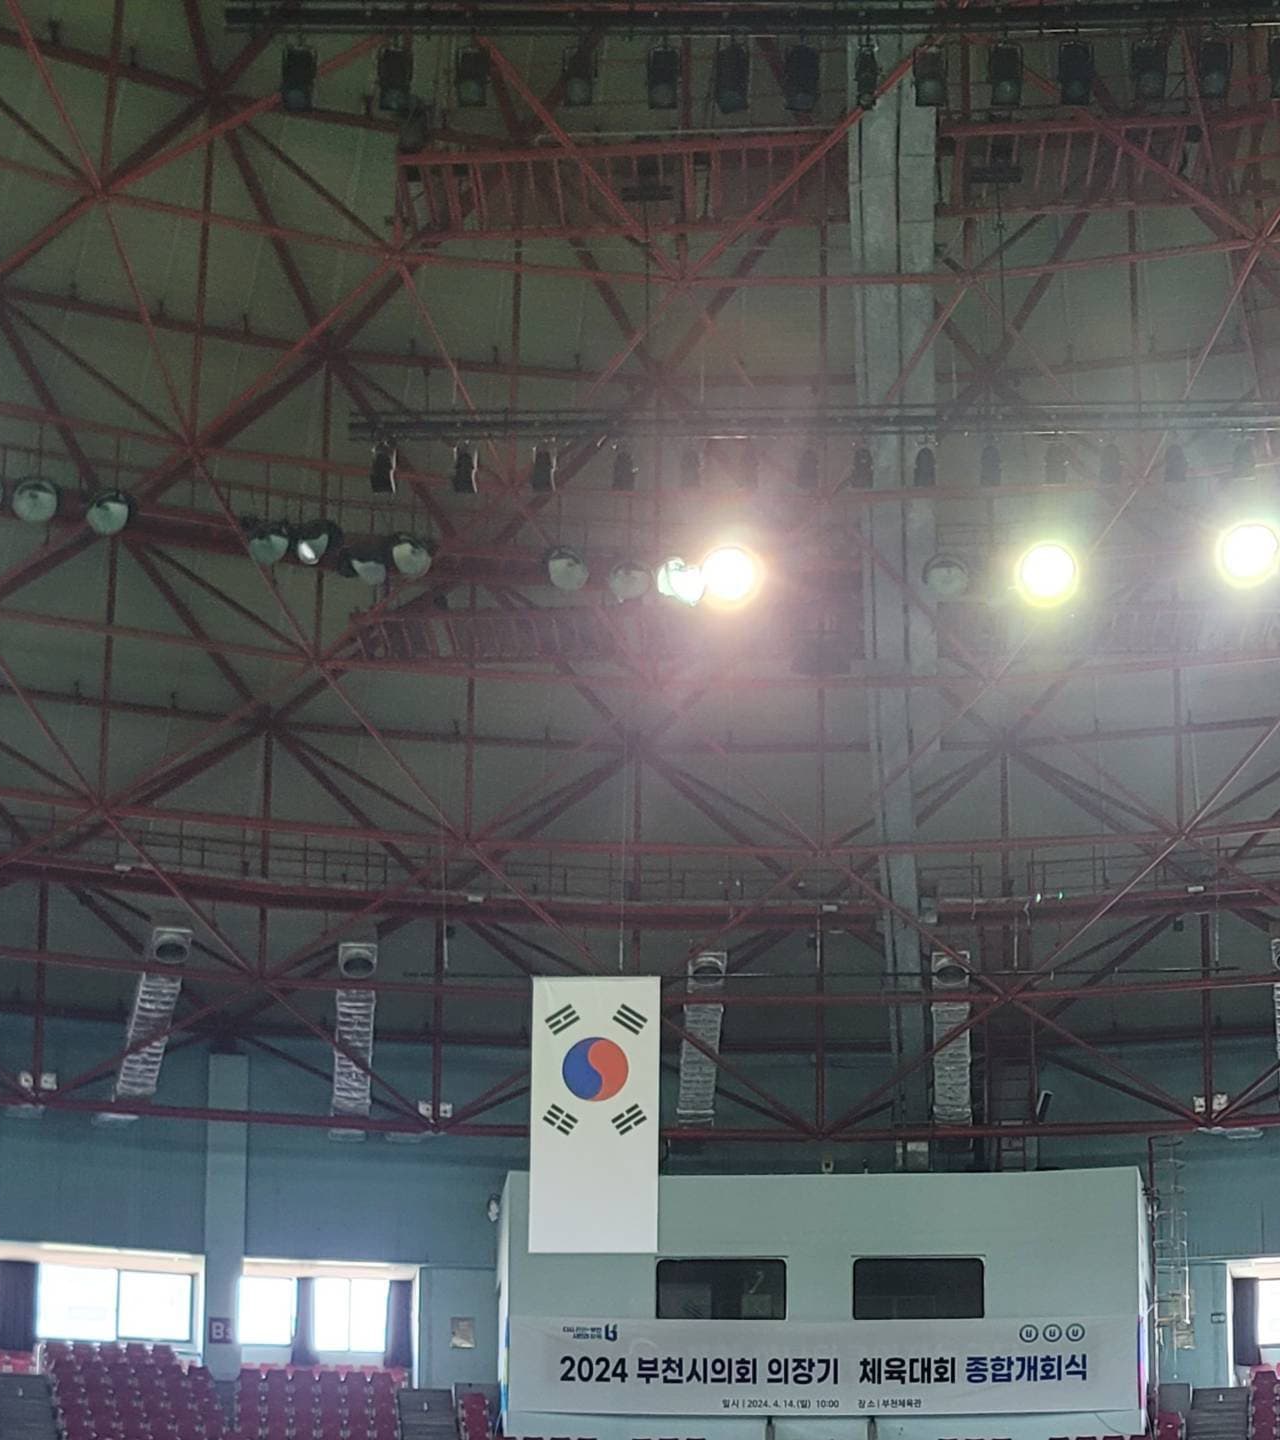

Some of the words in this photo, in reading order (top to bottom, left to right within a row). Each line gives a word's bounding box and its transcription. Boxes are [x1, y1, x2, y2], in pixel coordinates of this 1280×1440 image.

[559, 1355, 629, 1383] 2024
[636, 1356, 758, 1385] 부천시의회
[766, 1357, 839, 1385] 의장기
[858, 1356, 956, 1385] 체육대회
[965, 1354, 1087, 1384] 종합개회식
[816, 1399, 840, 1408] 10:00
[881, 1399, 922, 1409] 부천체육관
